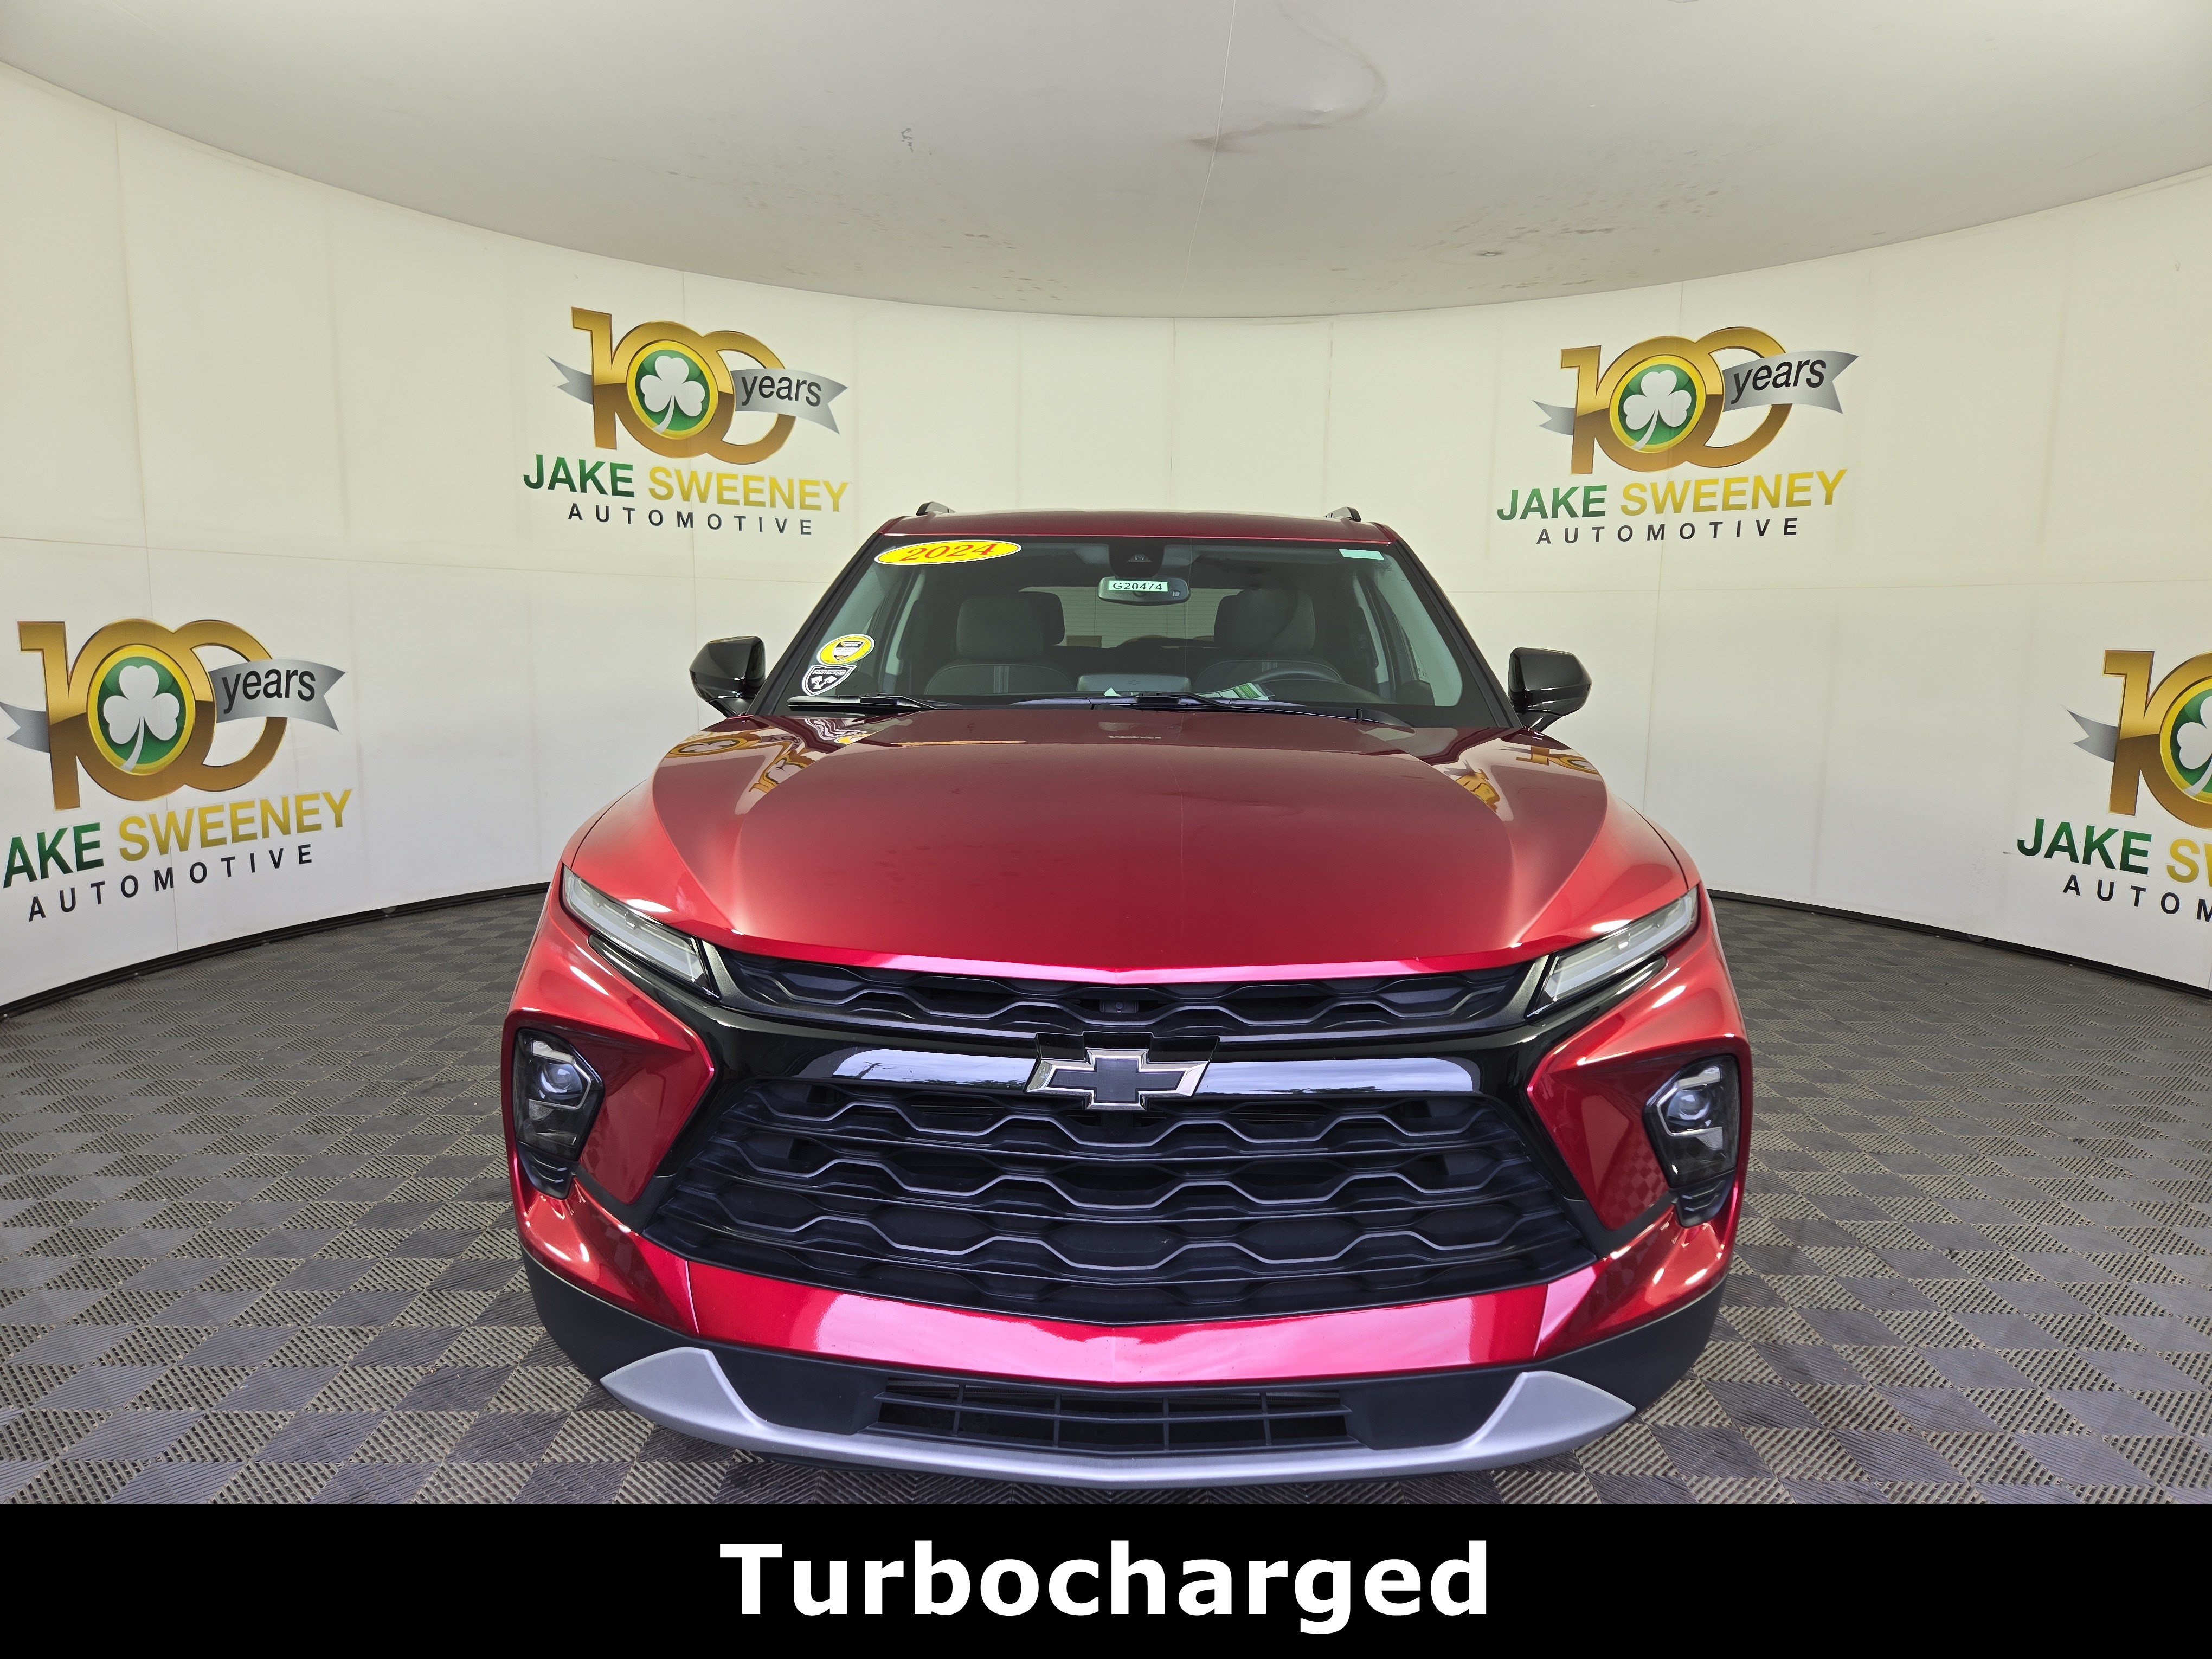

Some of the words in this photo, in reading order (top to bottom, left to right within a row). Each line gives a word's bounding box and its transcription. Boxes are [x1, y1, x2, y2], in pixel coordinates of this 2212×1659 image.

[571, 307, 796, 465] 100
[741, 375, 822, 407] years
[1561, 326, 1792, 474] 100
[1731, 358, 1827, 404] years
[523, 454, 635, 497] JAKE
[648, 466, 849, 512] SWEENEY
[1497, 485, 1607, 521] JAKE
[1621, 468, 1848, 516] SWEENEY
[568, 503, 812, 535] AUTOMOTIVE
[1536, 518, 1798, 544] AUTOMOTIVE
[899, 544, 998, 562] 2024
[1113, 582, 1163, 590] G20474
[18, 618, 287, 811] 100
[222, 668, 316, 713] years
[119, 789, 352, 861] SWEENEY
[2017, 818, 2152, 875] JAKE
[29, 844, 312, 922] AUTOMOTIVE
